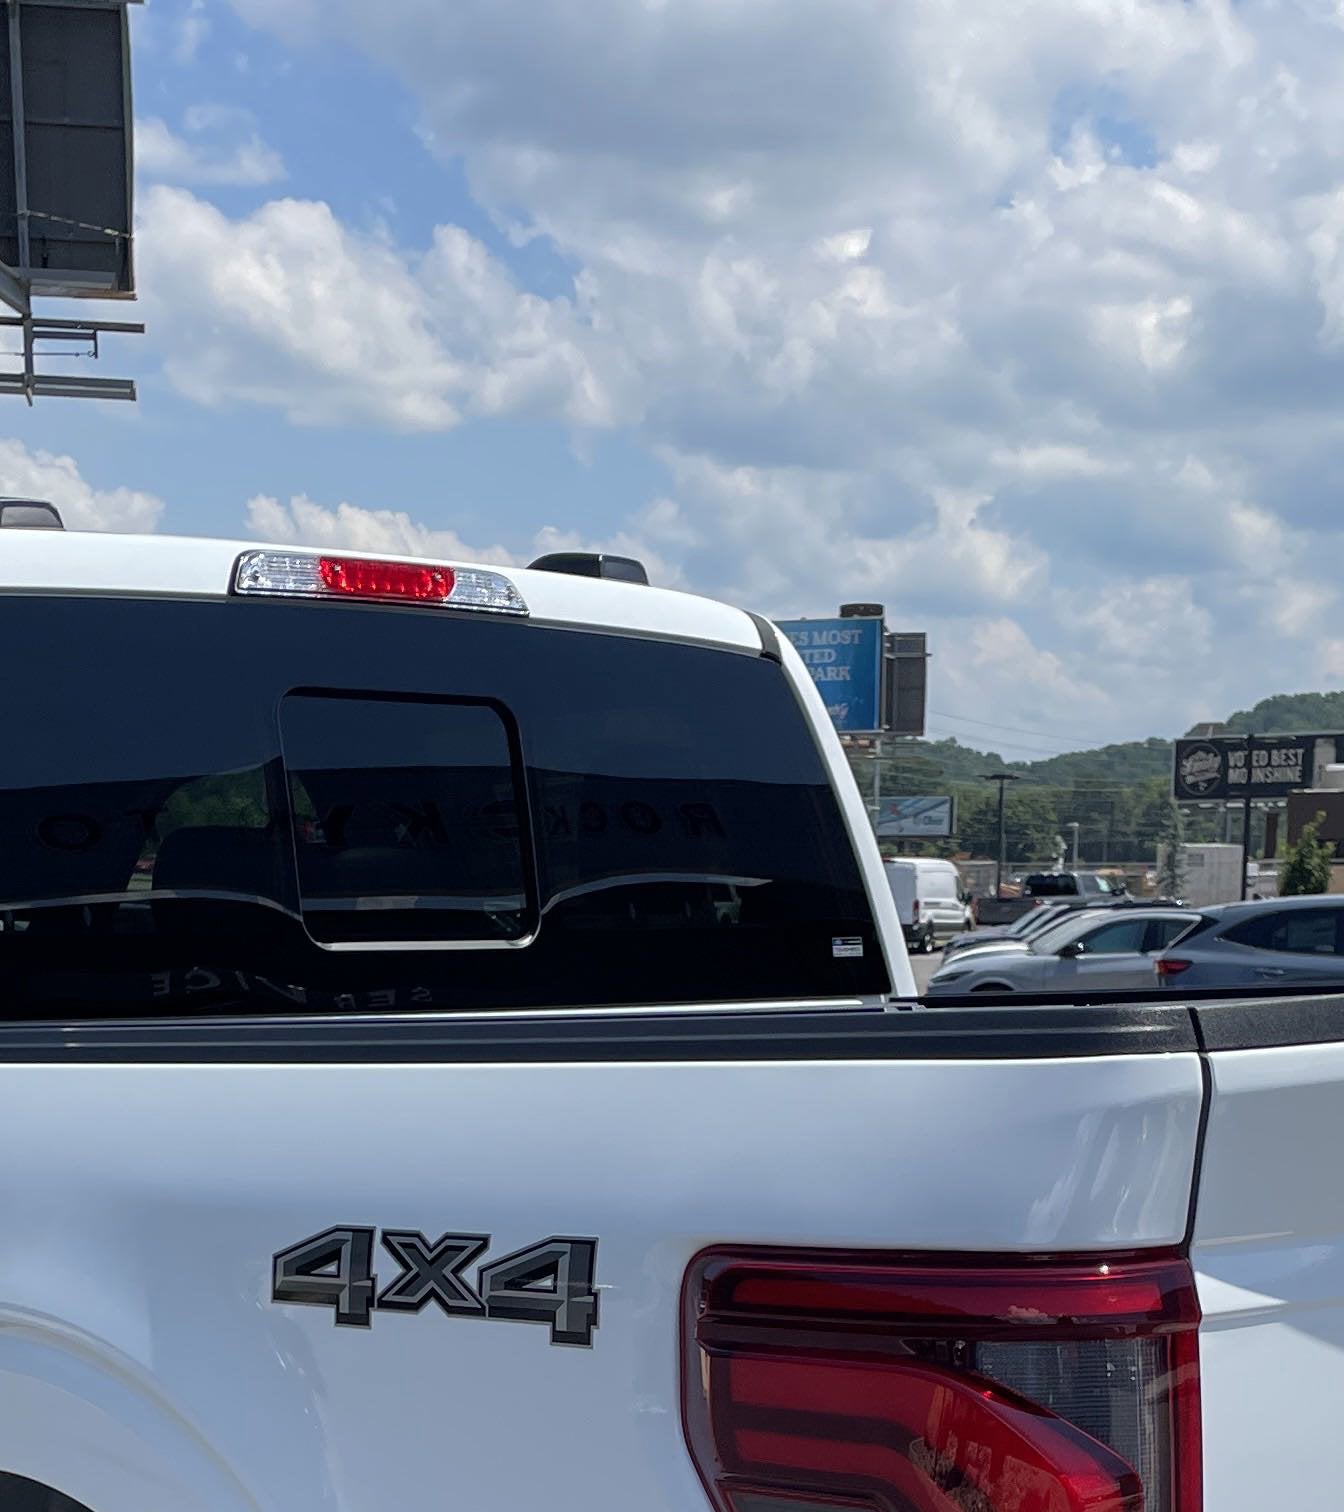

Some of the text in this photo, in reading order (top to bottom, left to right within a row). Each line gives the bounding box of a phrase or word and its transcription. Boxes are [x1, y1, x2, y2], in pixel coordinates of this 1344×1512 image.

[812, 630, 863, 645] MOST
[800, 649, 837, 664] TED
[1271, 748, 1304, 766] BEST
[1227, 766, 1302, 784] MONSHINE
